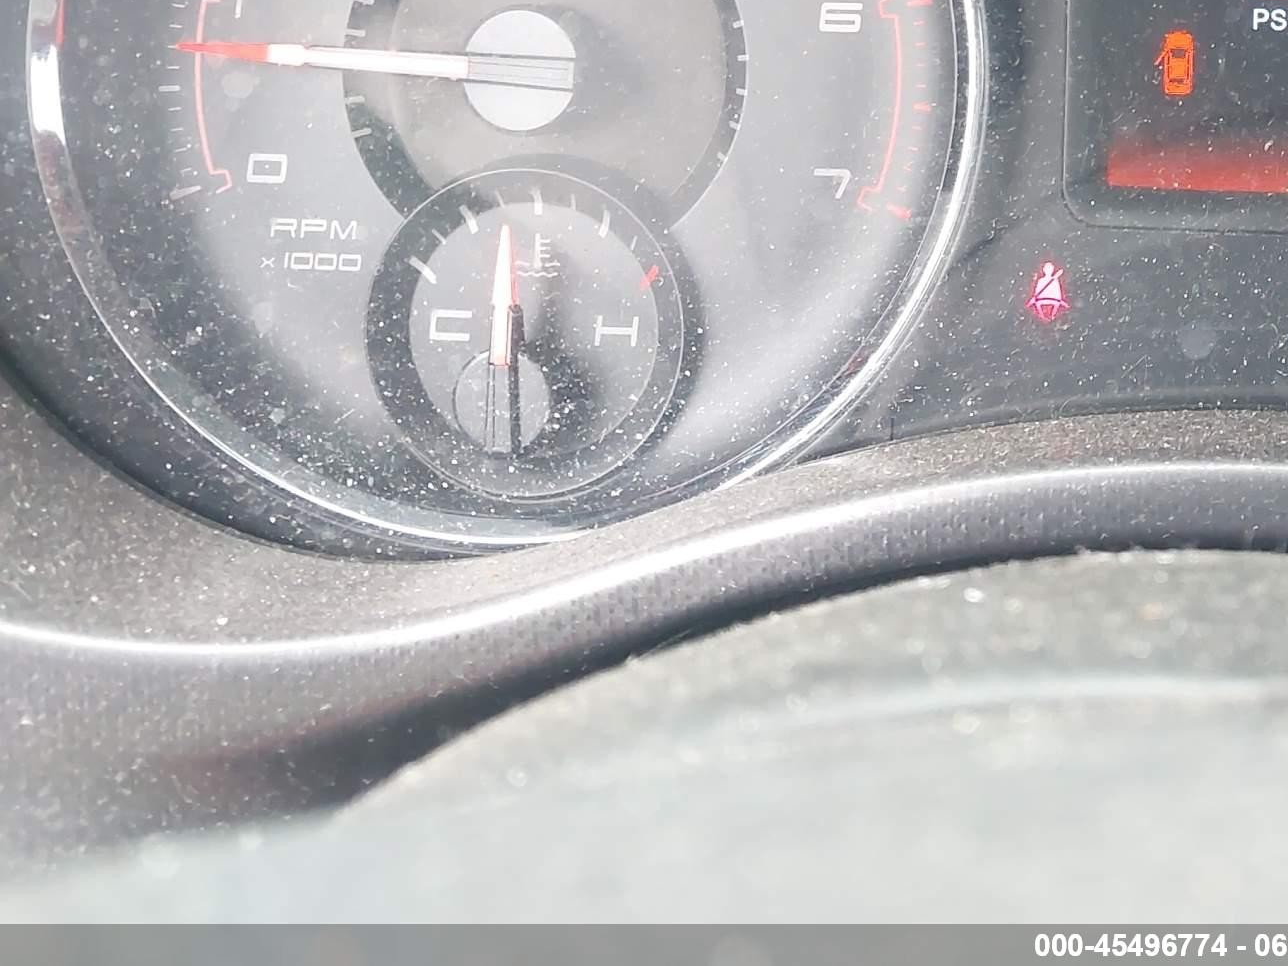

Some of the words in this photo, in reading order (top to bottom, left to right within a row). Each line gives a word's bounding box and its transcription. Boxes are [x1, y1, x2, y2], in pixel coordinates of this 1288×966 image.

[819, 2, 863, 33] 6
[246, 154, 288, 185] 0
[813, 169, 852, 199] 7
[269, 218, 358, 240] RPM
[283, 252, 362, 273] 1000
[429, 309, 472, 342] C
[594, 314, 639, 347] H
